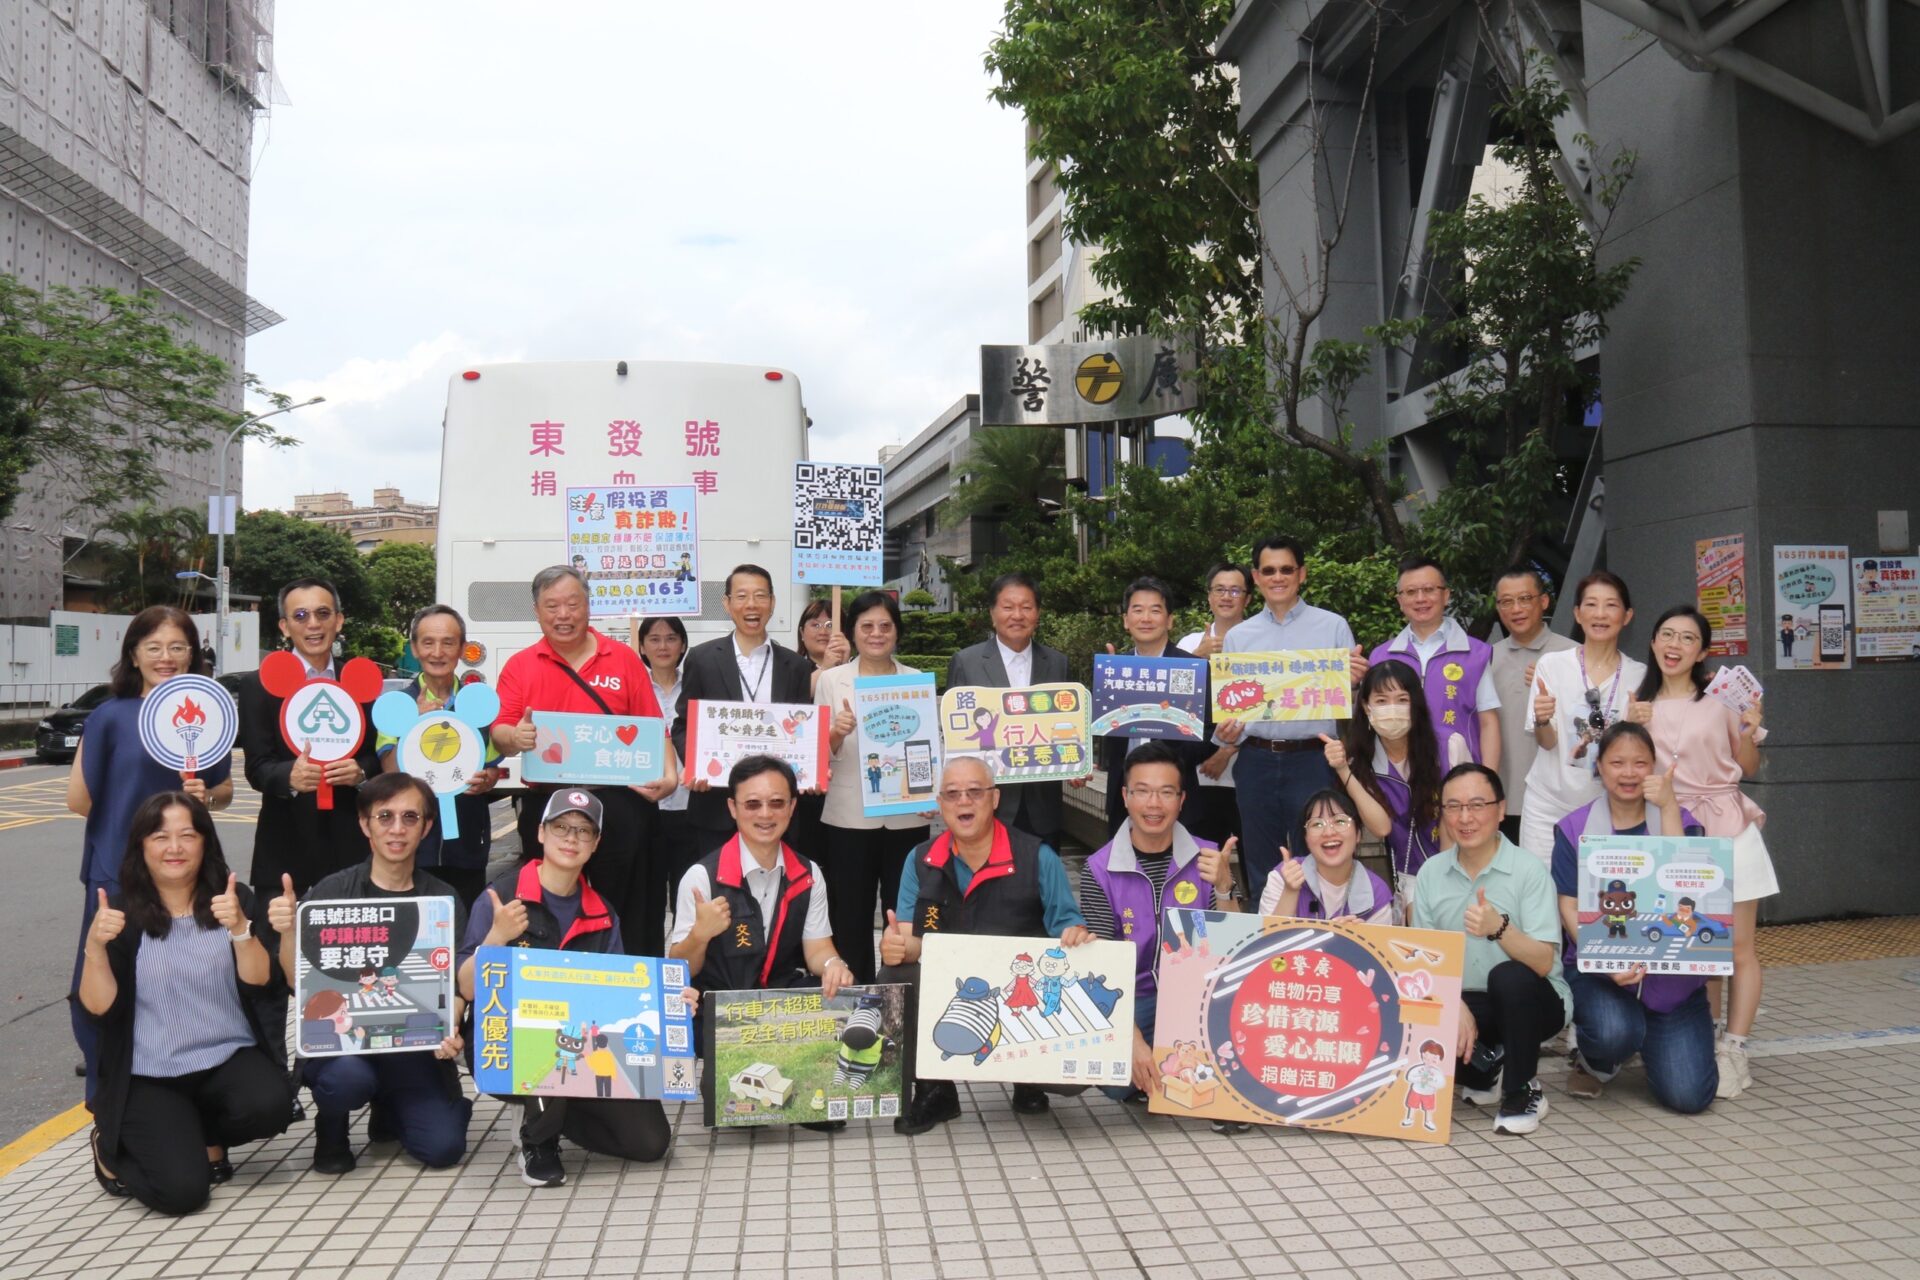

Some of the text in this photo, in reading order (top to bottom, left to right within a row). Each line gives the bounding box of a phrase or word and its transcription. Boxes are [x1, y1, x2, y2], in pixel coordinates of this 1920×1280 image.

[529, 420, 721, 457] 東發號
[606, 490, 668, 509] 假投資
[601, 554, 666, 569] 皆是詐騙
[589, 675, 621, 690] JJS
[1104, 666, 1167, 680] 中華民國
[1104, 679, 1167, 692] 汽車安全協會
[1226, 687, 1256, 706] 小心
[1280, 687, 1346, 709] 是詐騙
[950, 691, 976, 730] 路口
[574, 724, 613, 744] 安心
[1003, 724, 1049, 747] 行人
[594, 748, 652, 769] 食物包
[1009, 744, 1080, 767] 停看聽
[309, 907, 395, 925] 無號誌路口
[924, 906, 939, 930] 交大
[1122, 907, 1134, 941] 施富
[320, 927, 389, 945] 停讓標誌
[736, 923, 752, 948] 交大
[320, 945, 389, 970] 要遵守
[436, 953, 449, 966] 停
[1291, 954, 1333, 978] 警廣
[1268, 981, 1342, 1004] 惜物分享
[481, 961, 509, 1070] 行人優先
[725, 994, 823, 1022] 行車不超速
[1240, 1002, 1340, 1034] 珍惜資源
[740, 1017, 836, 1044] 安全有保障
[1263, 1034, 1362, 1065] 愛心無限
[1260, 1065, 1336, 1090] 捐贈活動
